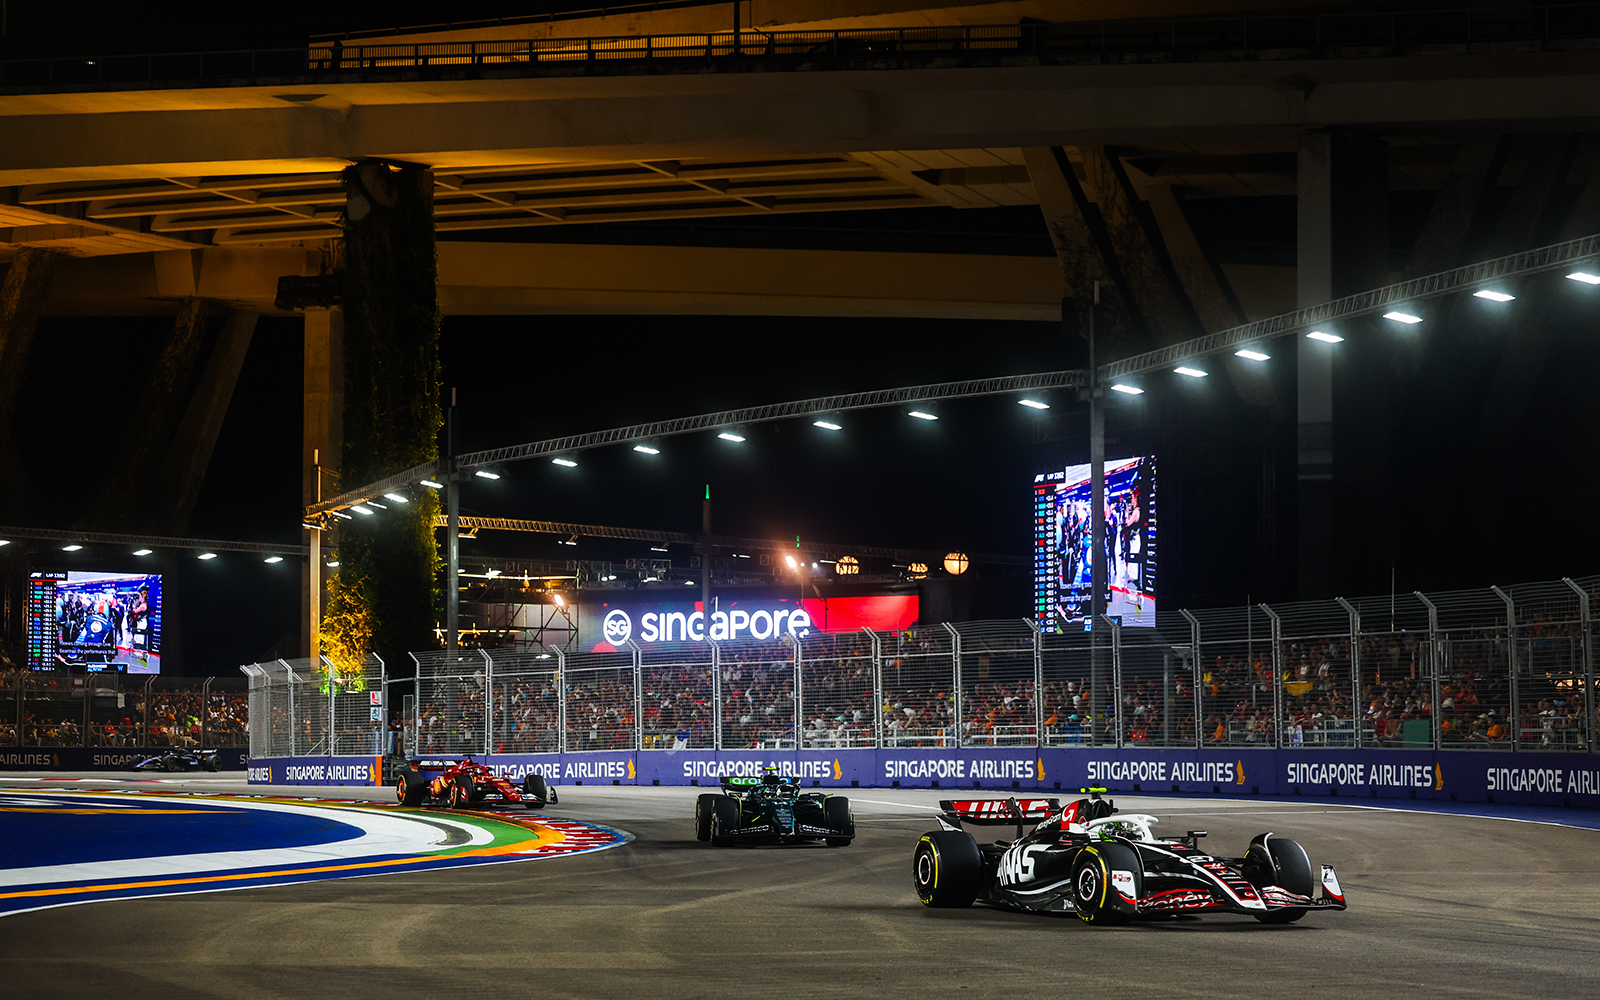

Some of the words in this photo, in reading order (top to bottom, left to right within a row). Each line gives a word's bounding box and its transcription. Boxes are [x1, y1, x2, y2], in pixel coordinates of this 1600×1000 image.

[0, 753, 50, 765] AIRLINES
[286, 765, 324, 780] SINGAPORE
[326, 765, 368, 780] AIRLINES
[564, 761, 625, 779] AIRLINES
[683, 760, 763, 778] SINGAPORE
[885, 759, 964, 778] SINGAPORE
[970, 759, 1034, 779] AIRLINES
[1087, 761, 1166, 781] SINGAPORE
[1171, 761, 1234, 782] AIRLINES
[1287, 762, 1364, 785] SINGAPORE
[1369, 764, 1433, 788] AIRLINES
[1487, 767, 1563, 793] SINGAPORE
[1567, 769, 1600, 795] AIRLI
